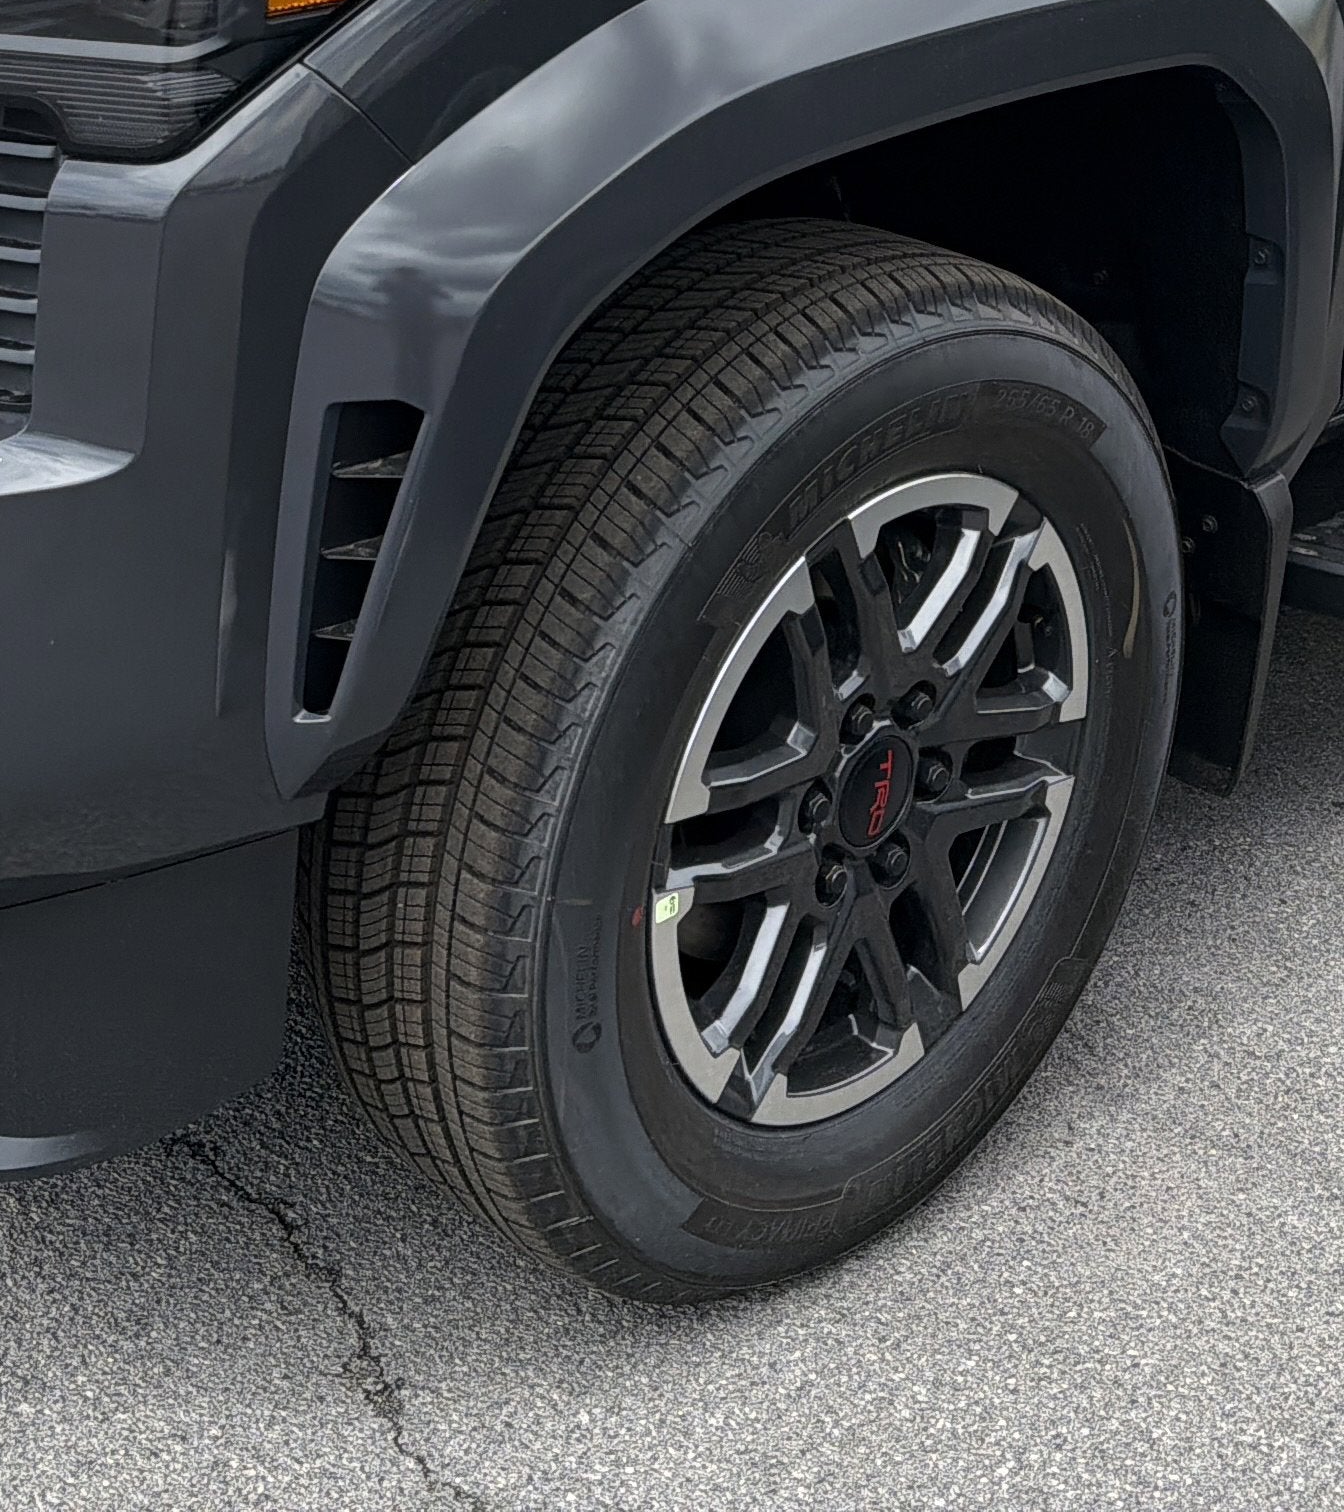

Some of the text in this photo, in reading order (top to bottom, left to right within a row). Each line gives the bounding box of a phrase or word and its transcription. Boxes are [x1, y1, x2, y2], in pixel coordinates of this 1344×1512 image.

[1058, 405, 1076, 426] R
[1075, 416, 1096, 440] 18
[867, 749, 894, 840] TRD
